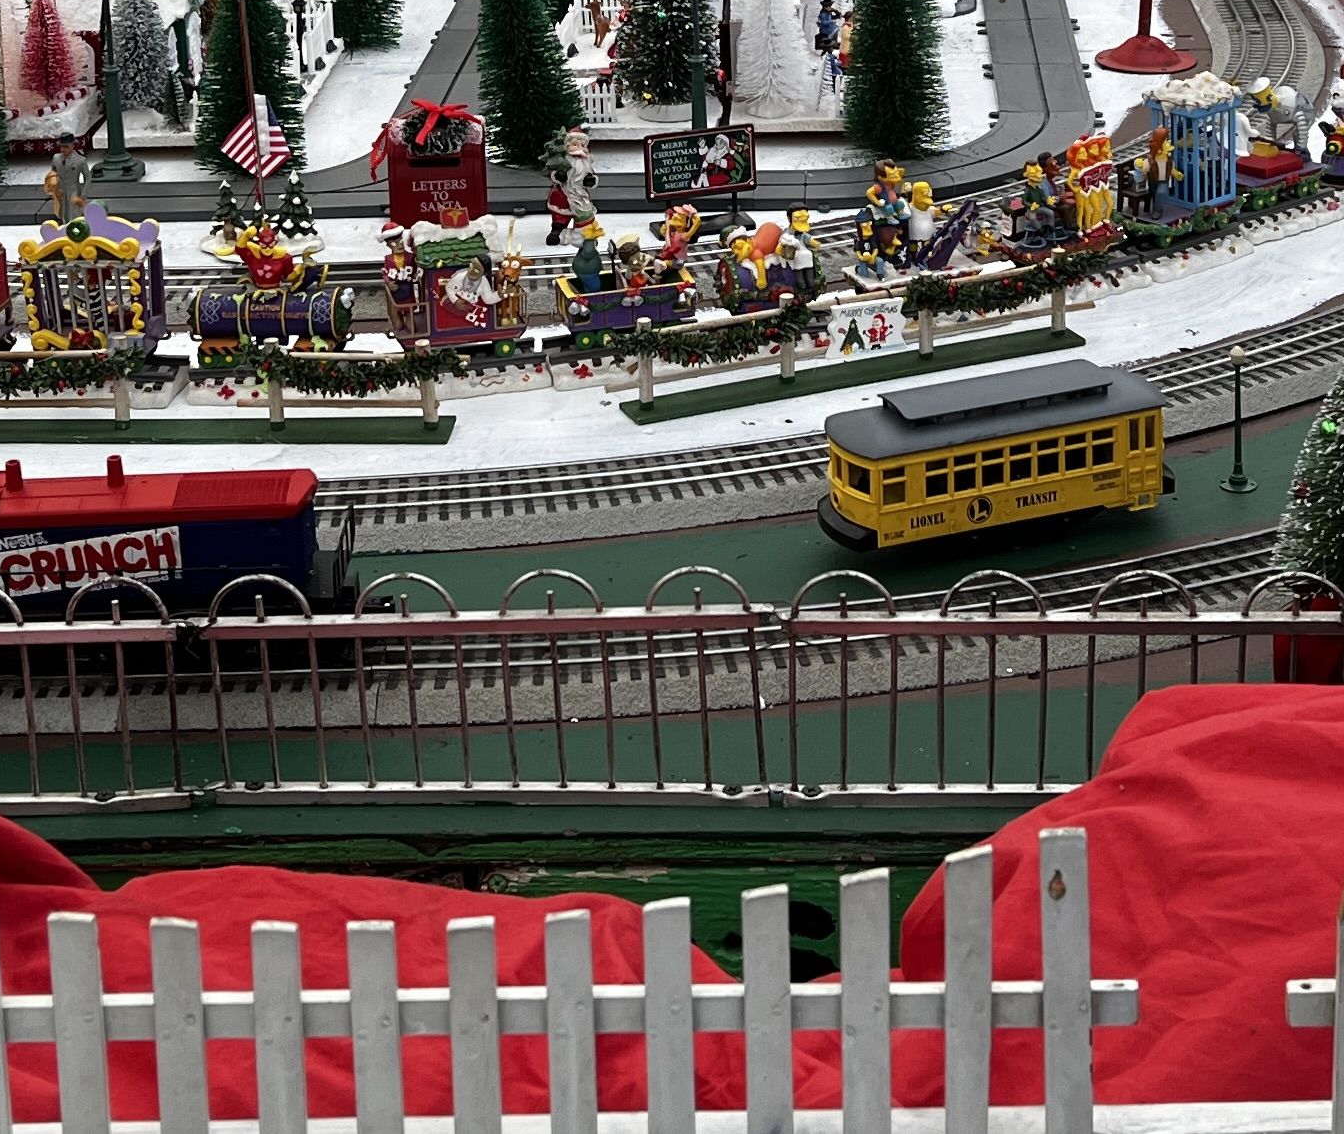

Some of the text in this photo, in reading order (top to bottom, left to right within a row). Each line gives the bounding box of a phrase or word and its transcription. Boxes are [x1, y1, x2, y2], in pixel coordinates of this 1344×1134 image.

[661, 141, 688, 150] MERRY
[653, 148, 697, 159] CHRISTMAS
[674, 156, 689, 164] ALL
[654, 163, 698, 175] AND TO ALL
[669, 173, 691, 181] GOOD
[412, 179, 467, 192] LETTERS
[664, 181, 689, 190] NIGHT
[431, 191, 449, 201] TO
[420, 201, 462, 213] SANTA
[840, 308, 863, 317] MERRY
[1016, 491, 1058, 508] TRANSIT
[910, 512, 946, 529] LIONEL
[0, 531, 177, 590] CRUNCH
